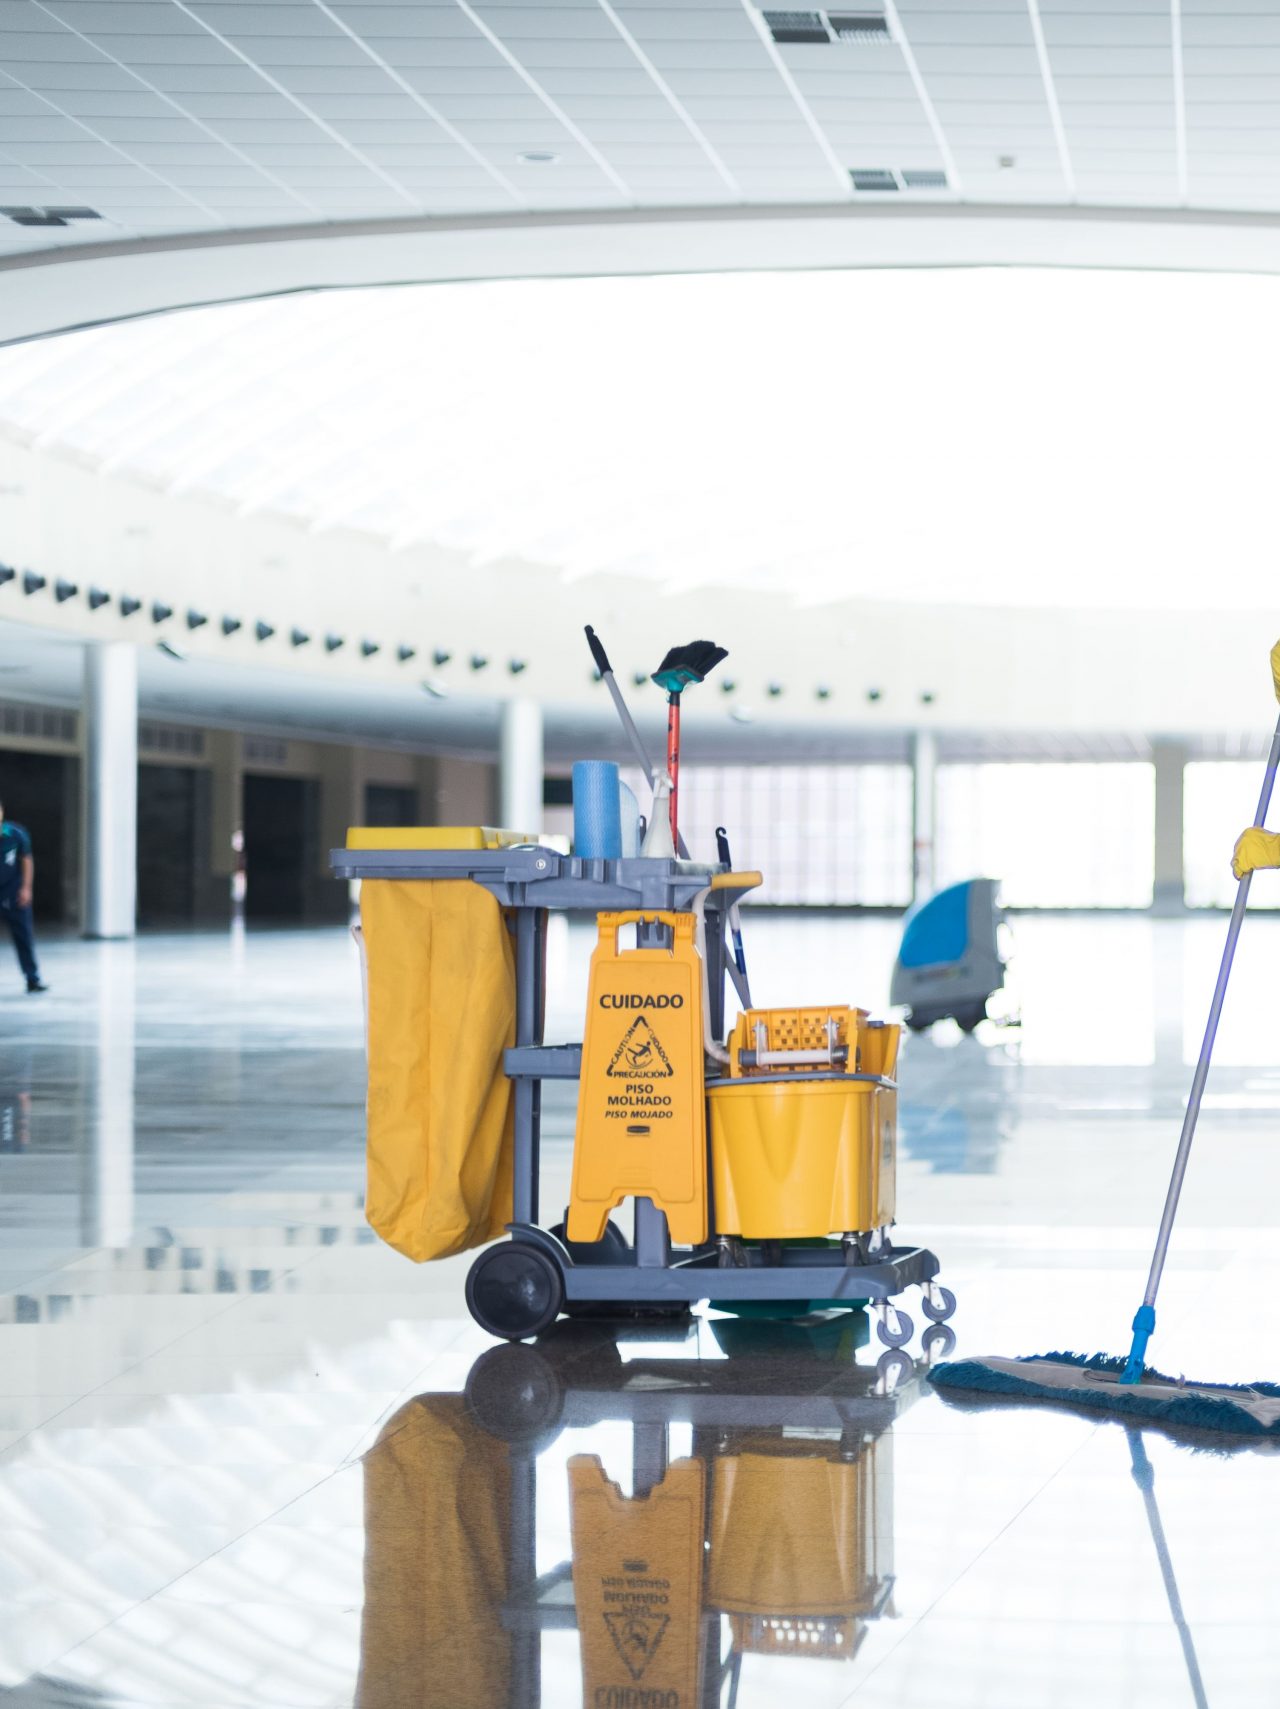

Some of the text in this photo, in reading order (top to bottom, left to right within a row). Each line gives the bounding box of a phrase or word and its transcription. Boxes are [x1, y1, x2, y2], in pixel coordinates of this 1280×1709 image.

[599, 994, 684, 1009] CUIDADO
[611, 1027, 635, 1065] CAUTION
[626, 1084, 653, 1094] PISO
[607, 1096, 672, 1106] MOLHADO
[605, 1110, 673, 1119] PISO MOJADO
